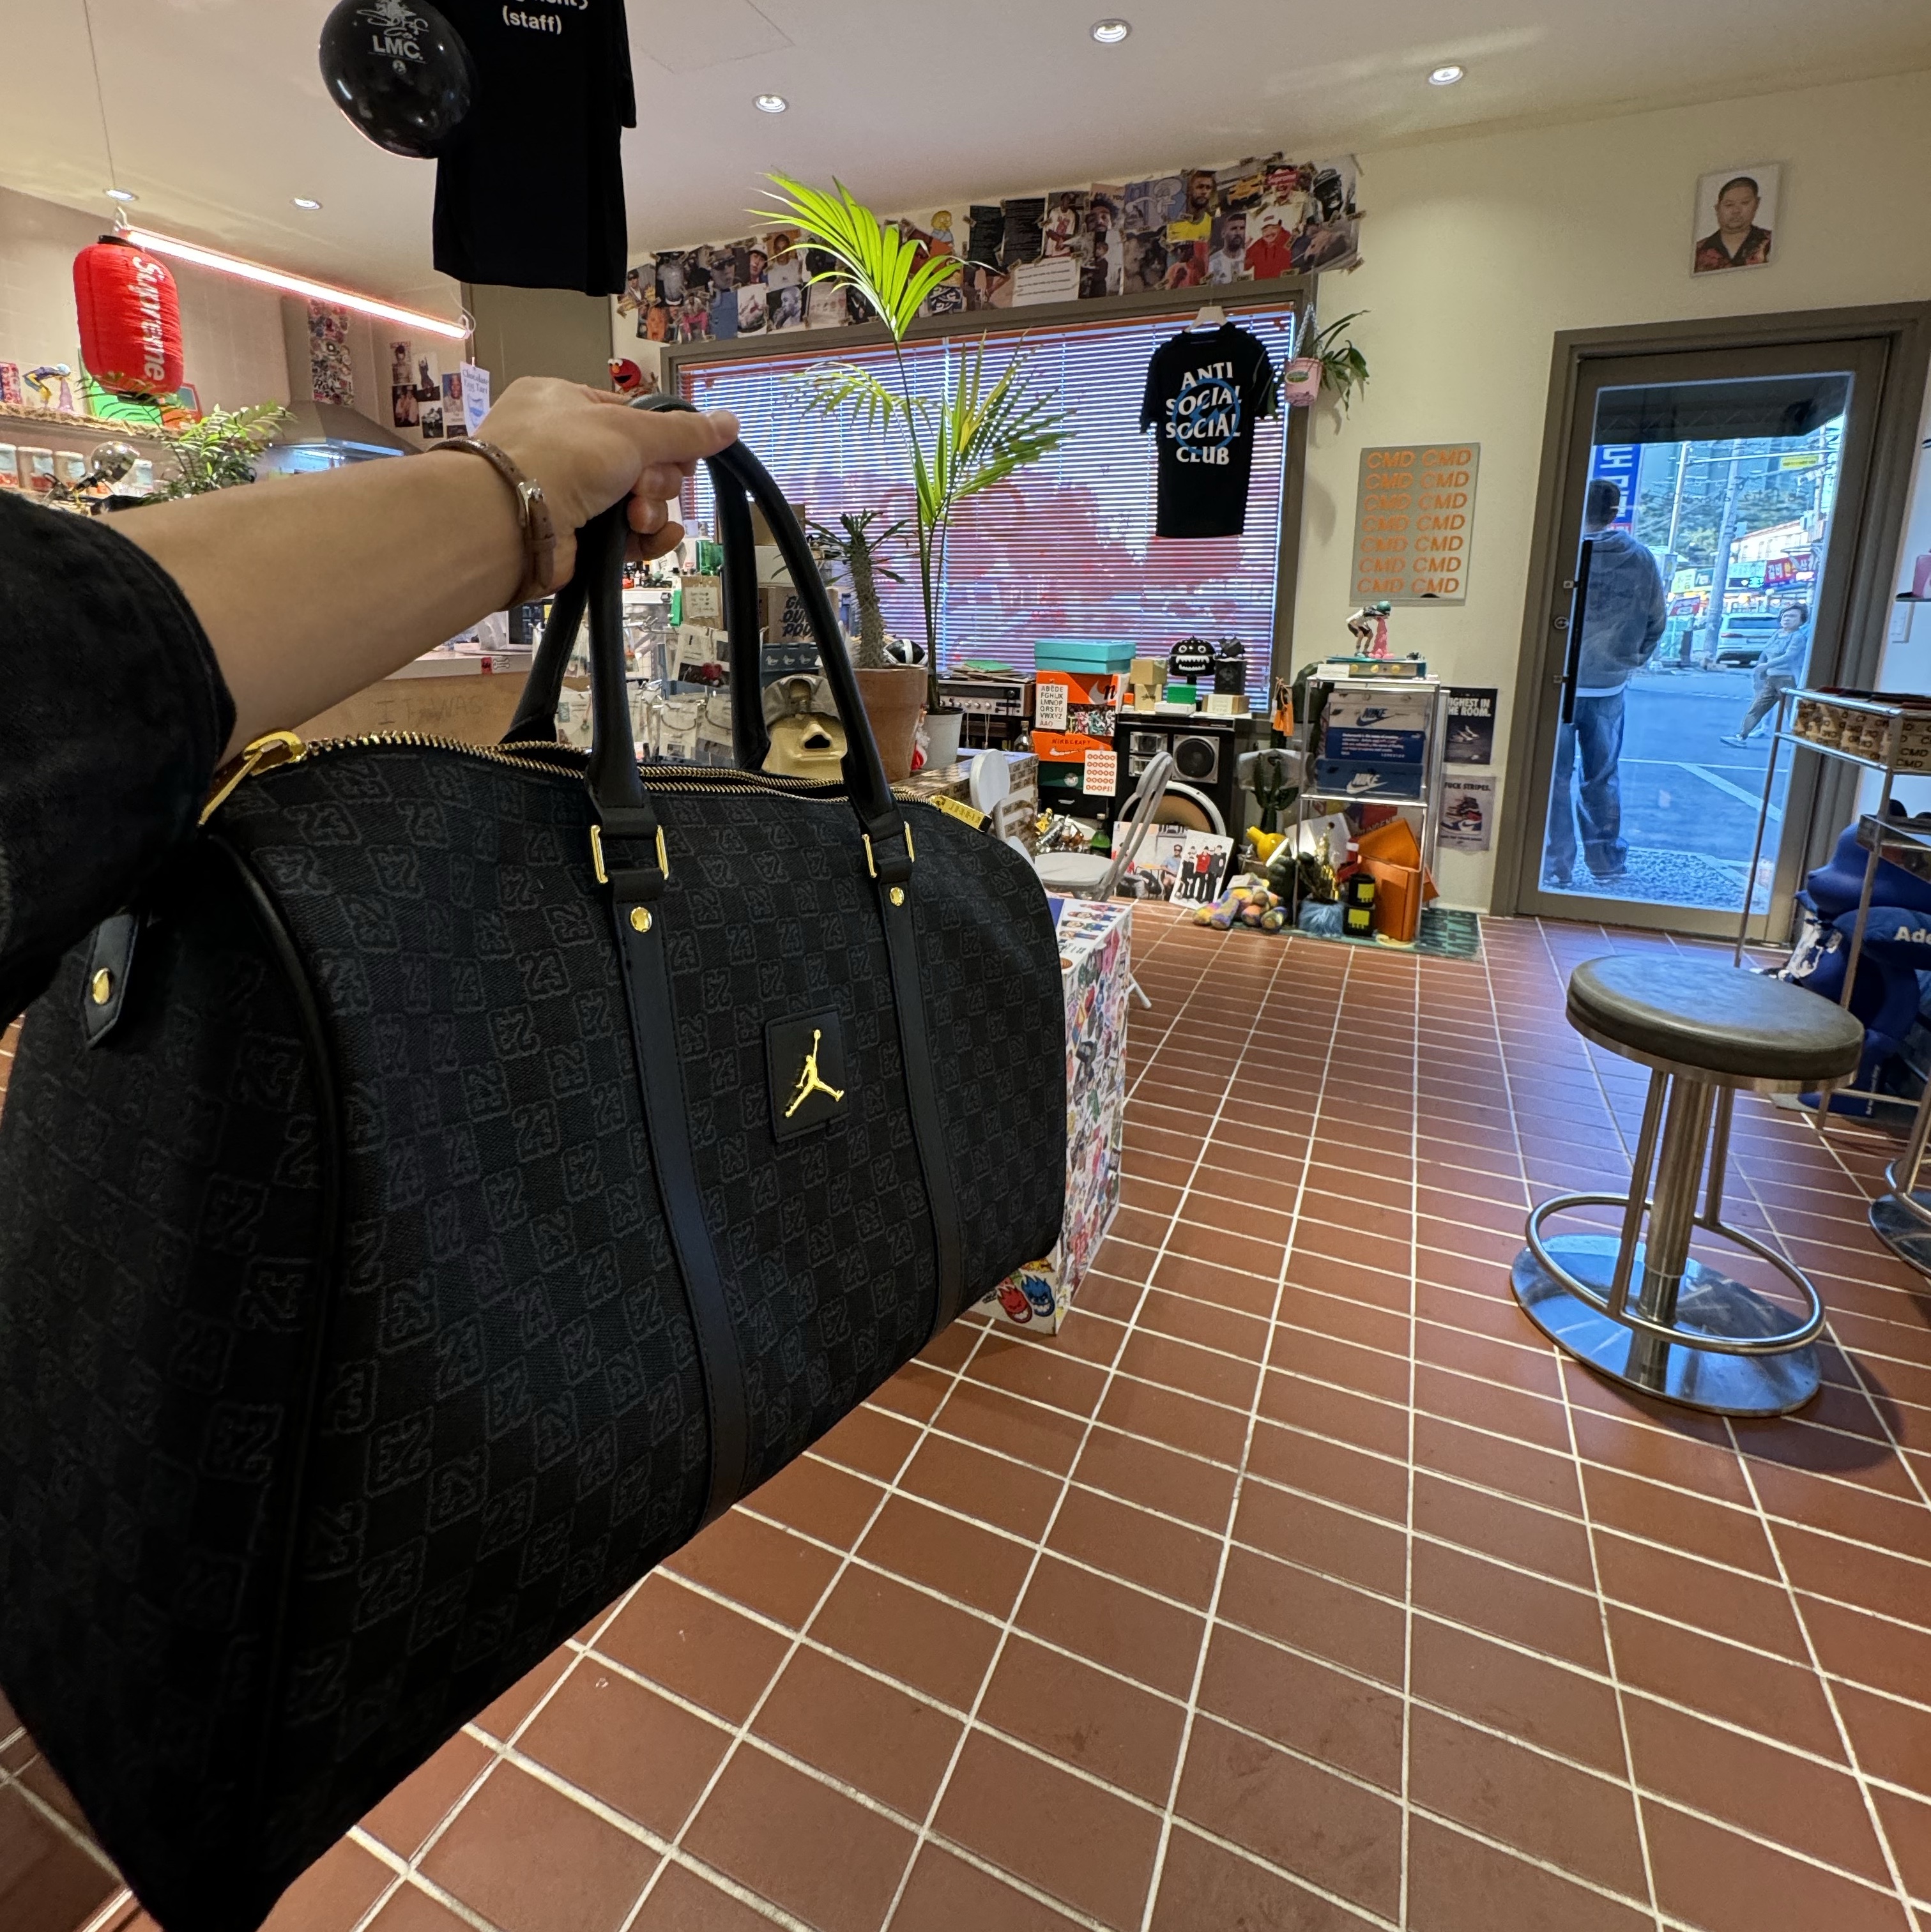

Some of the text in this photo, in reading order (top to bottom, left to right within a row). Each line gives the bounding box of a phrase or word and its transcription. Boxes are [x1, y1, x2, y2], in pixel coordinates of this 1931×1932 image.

[502, 6, 562, 34] (staff)
[372, 34, 424, 61] LMC.
[128, 256, 165, 381] Supreme
[1180, 361, 1233, 390] ANTI
[1165, 386, 1242, 416] SOCIAL
[1165, 413, 1241, 439] SOCIAL
[1176, 446, 1230, 465] CLUB
[1366, 448, 1472, 469] CMD CMD
[1366, 470, 1470, 490] CMD CMD
[1364, 492, 1468, 511] CMD CMD
[1362, 513, 1466, 532] CMD CMD
[1361, 535, 1464, 552] CMD CMD
[1359, 556, 1462, 574] CMD CMD
[1357, 577, 1460, 593] CMD CMD
[1448, 707, 1492, 717] HE ROOM.
[1449, 697, 1491, 708] IGHEST IN
[1362, 708, 1389, 719] NIKE
[1900, 748, 1928, 757] CMD
[1896, 758, 1923, 768] CMD
[1351, 773, 1381, 786] NIKE
